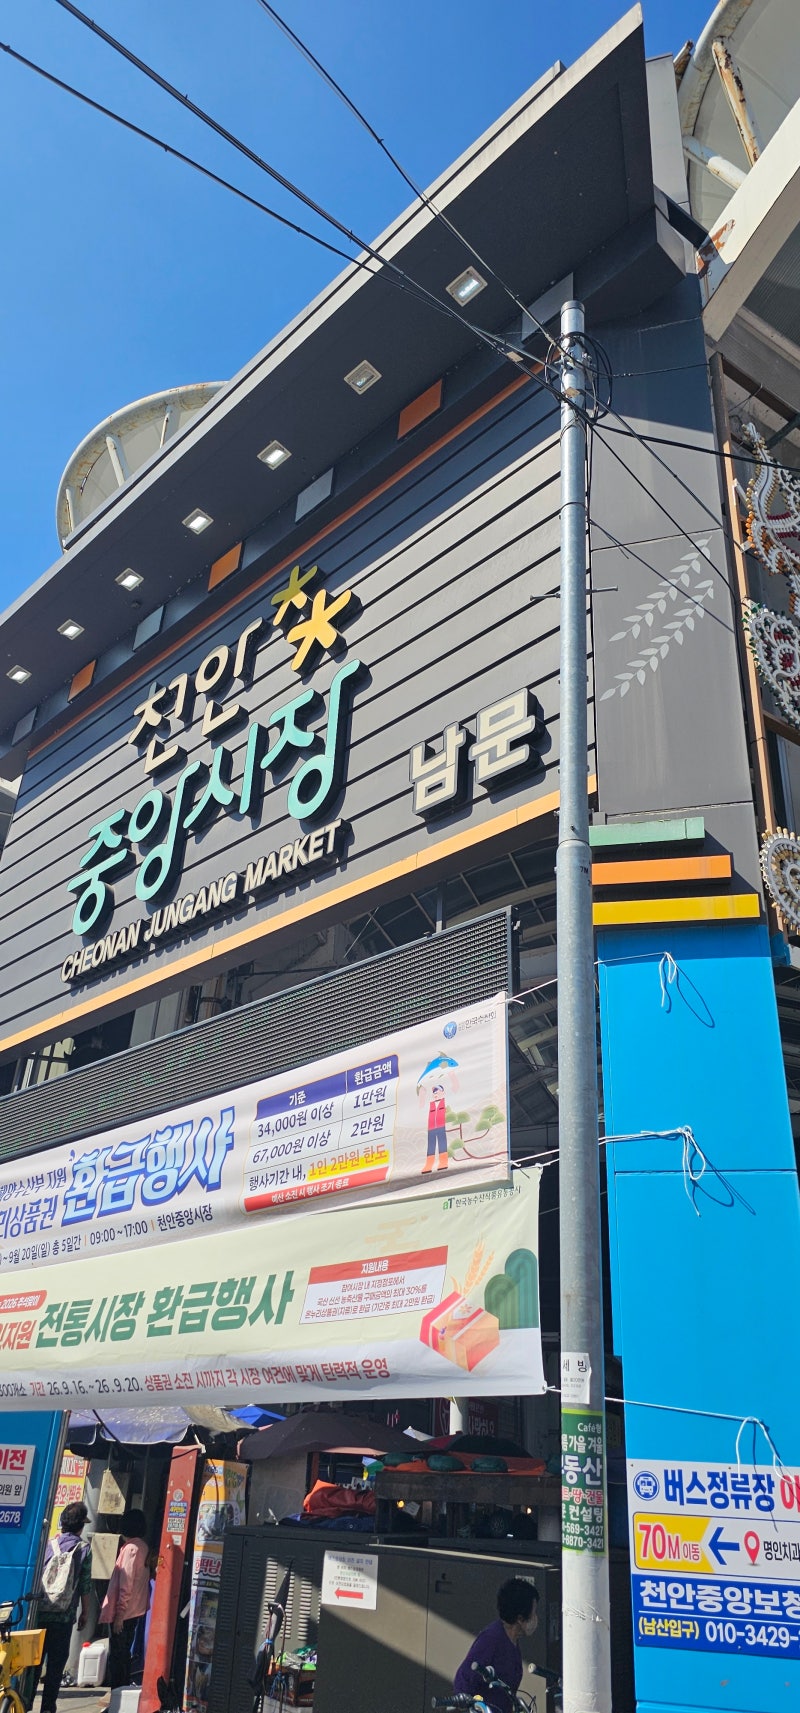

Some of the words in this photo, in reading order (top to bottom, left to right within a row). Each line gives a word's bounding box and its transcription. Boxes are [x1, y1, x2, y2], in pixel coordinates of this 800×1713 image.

[128, 616, 264, 776] 천안
[409, 688, 537, 816] 남문
[67, 659, 361, 935] 중앙시장
[60, 919, 141, 983] CHEONAN
[143, 871, 238, 943] JUNGANG
[243, 818, 342, 894] MARKET
[289, 1090, 307, 1106] 기준
[354, 1061, 392, 1086] 환급금액
[353, 1085, 387, 1109] 1만원
[257, 1109, 308, 1138] 34,000원
[311, 1102, 334, 1121] 이상
[350, 1113, 385, 1138] 2만원
[252, 1137, 304, 1164] 67,000원
[307, 1130, 331, 1149] 이상
[47, 1166, 66, 1190] 지원
[61, 1105, 235, 1227] 환급행사
[249, 1168, 289, 1192] 행사기간
[309, 1157, 327, 1177] 1인
[330, 1150, 360, 1172] 2만원
[363, 1144, 388, 1164] 한도
[306, 1185, 320, 1196] 행사
[320, 1181, 335, 1193] 조기
[157, 1204, 213, 1232] 천안중앙시장
[52, 1240, 60, 1256] 총
[62, 1235, 82, 1253] 5일간
[361, 1259, 389, 1274] 지원내용
[35, 1291, 146, 1348] 전통시장
[146, 1270, 295, 1337] 환급행사
[29, 1381, 46, 1397] 기간
[145, 1373, 174, 1392] 상품권
[174, 1372, 194, 1390] 소진
[196, 1369, 226, 1389] 시까지
[225, 1368, 239, 1387] 각
[240, 1367, 261, 1386] 시장
[261, 1365, 297, 1385] 여건에
[295, 1363, 323, 1383] 맞게
[320, 1360, 362, 1382] 탄력적
[361, 1358, 390, 1380] 운영
[561, 1454, 602, 1486] 동산
[663, 1469, 776, 1513] 버스정류장
[638, 1523, 681, 1560] 70M
[683, 1543, 701, 1561] 이동
[638, 1616, 700, 1640] (남산입구)
[705, 1621, 800, 1649] 010-3429-
